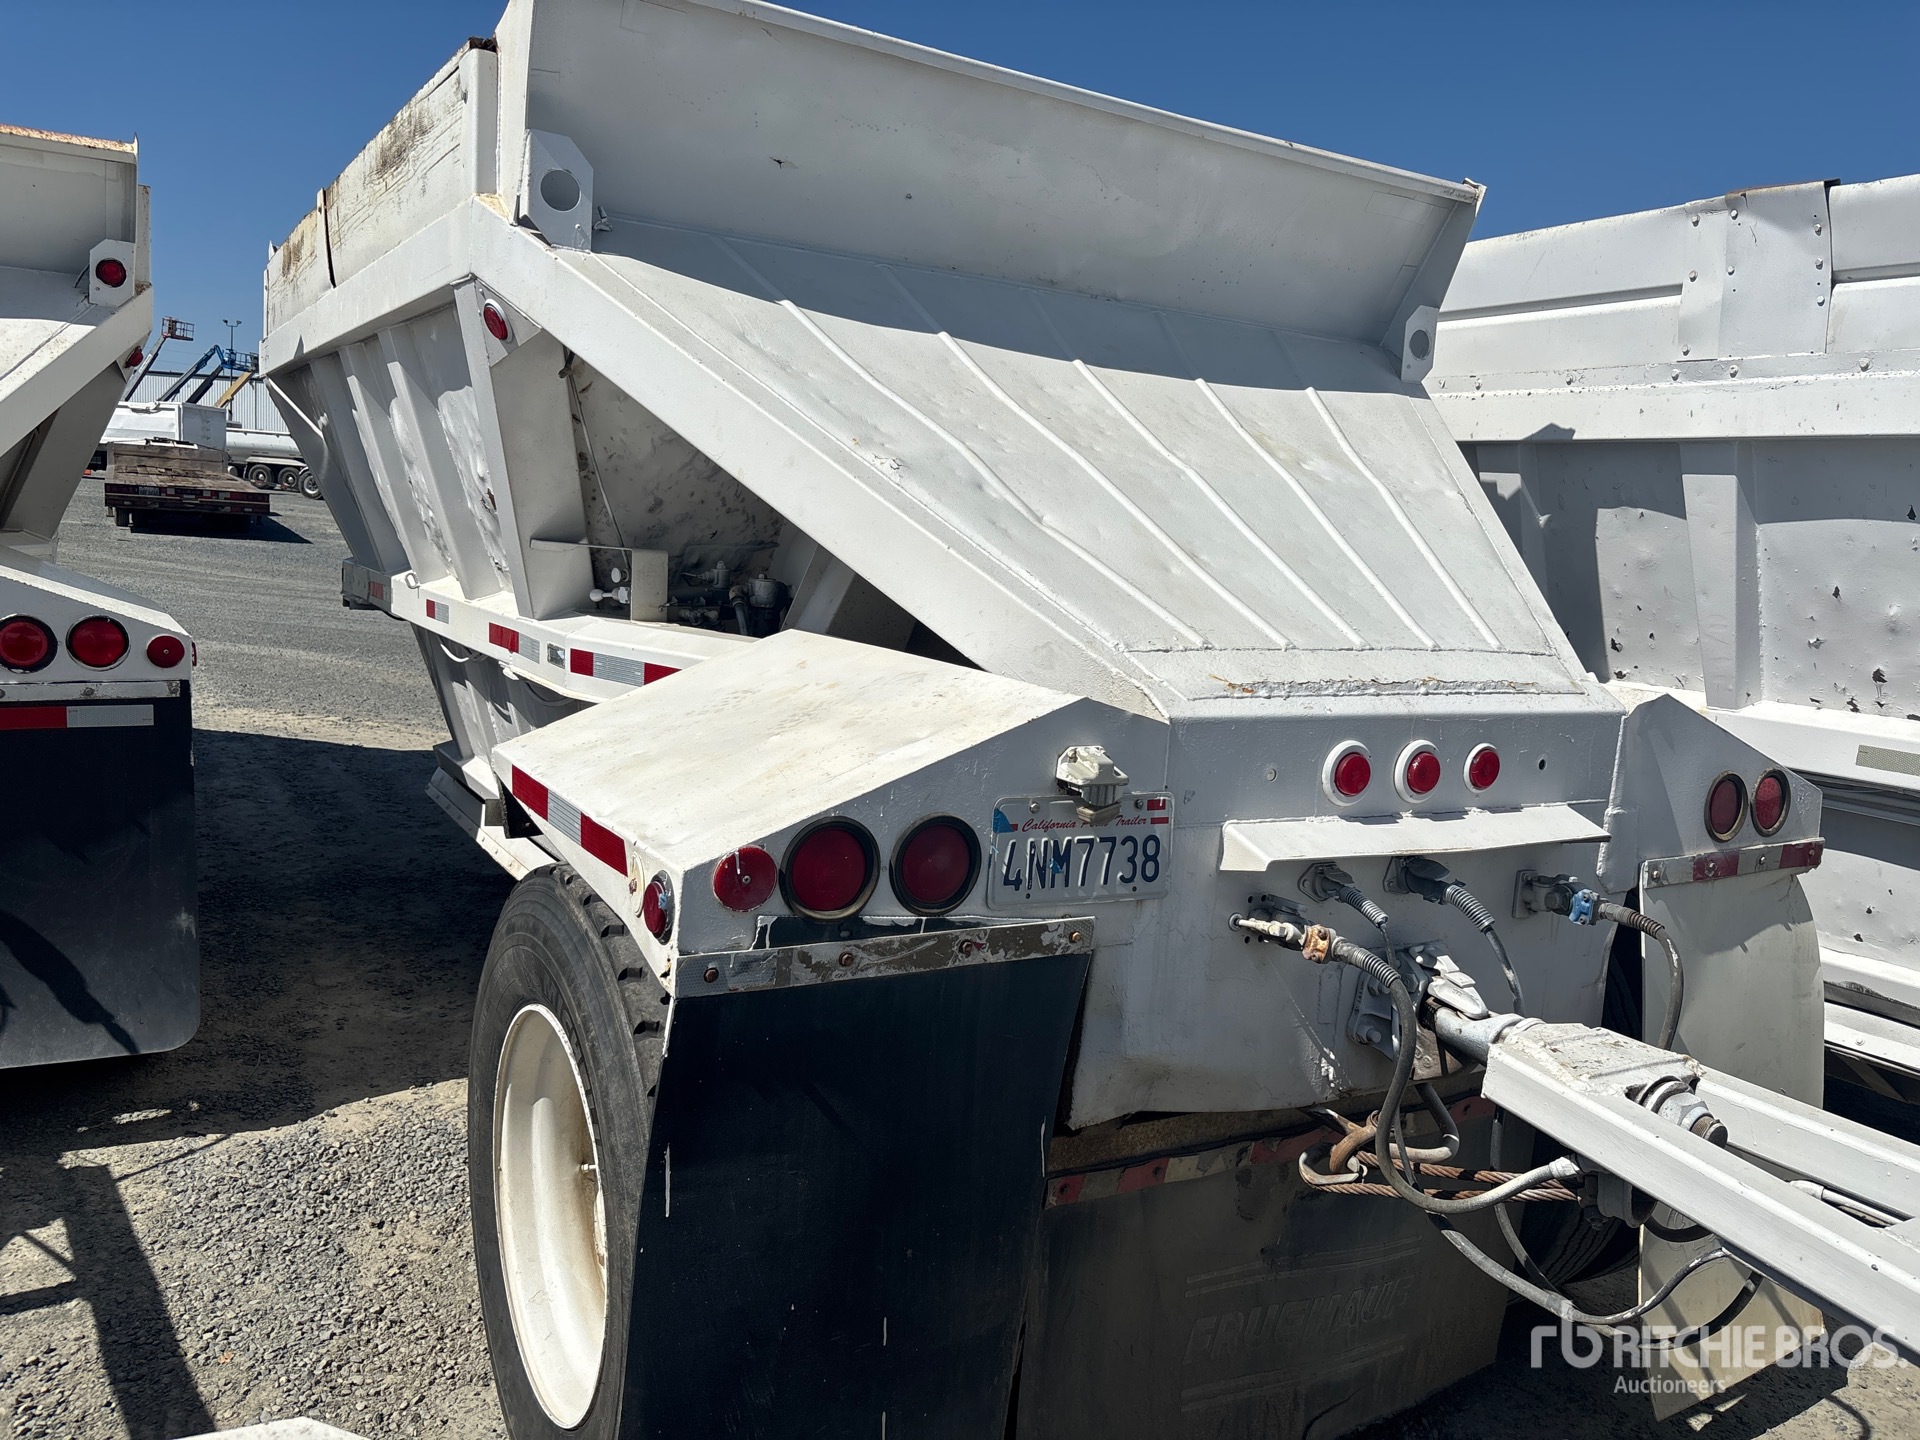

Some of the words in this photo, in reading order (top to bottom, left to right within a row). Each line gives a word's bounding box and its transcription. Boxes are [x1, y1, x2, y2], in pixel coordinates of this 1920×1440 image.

[1022, 818, 1076, 832] California
[1114, 815, 1147, 826] Trailer
[1002, 834, 1161, 891] 4NM7738
